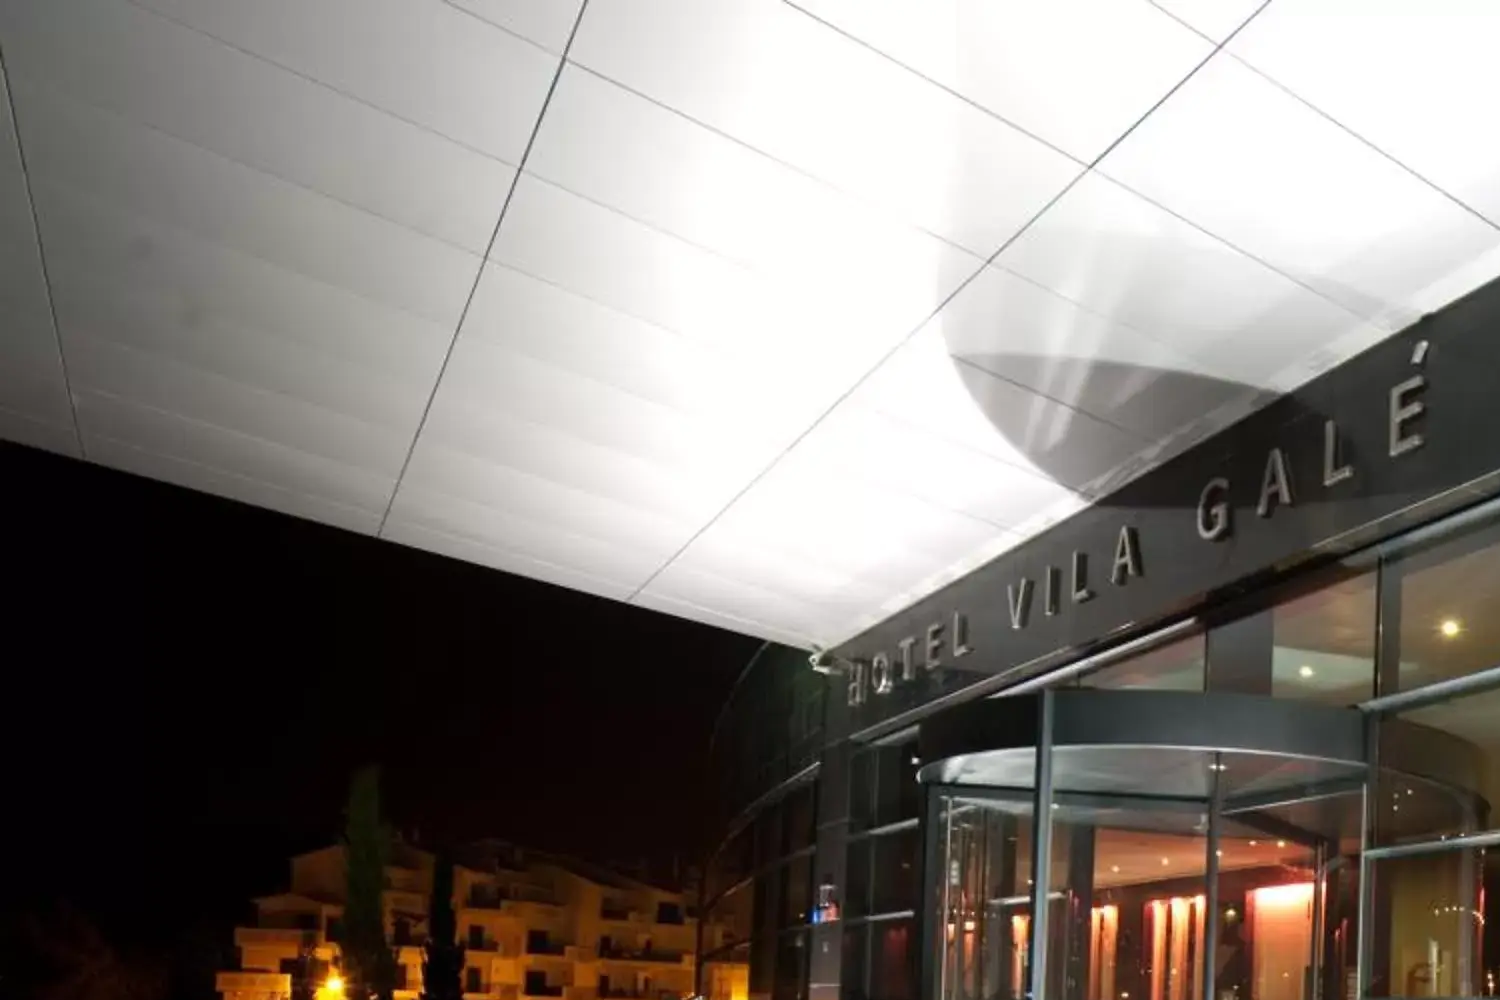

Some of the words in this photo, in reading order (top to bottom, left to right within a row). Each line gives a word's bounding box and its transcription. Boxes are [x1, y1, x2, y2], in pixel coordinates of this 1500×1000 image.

[850, 609, 972, 706] HOTEL
[1007, 525, 1143, 629] VILA
[1197, 340, 1428, 540] GALÉ
